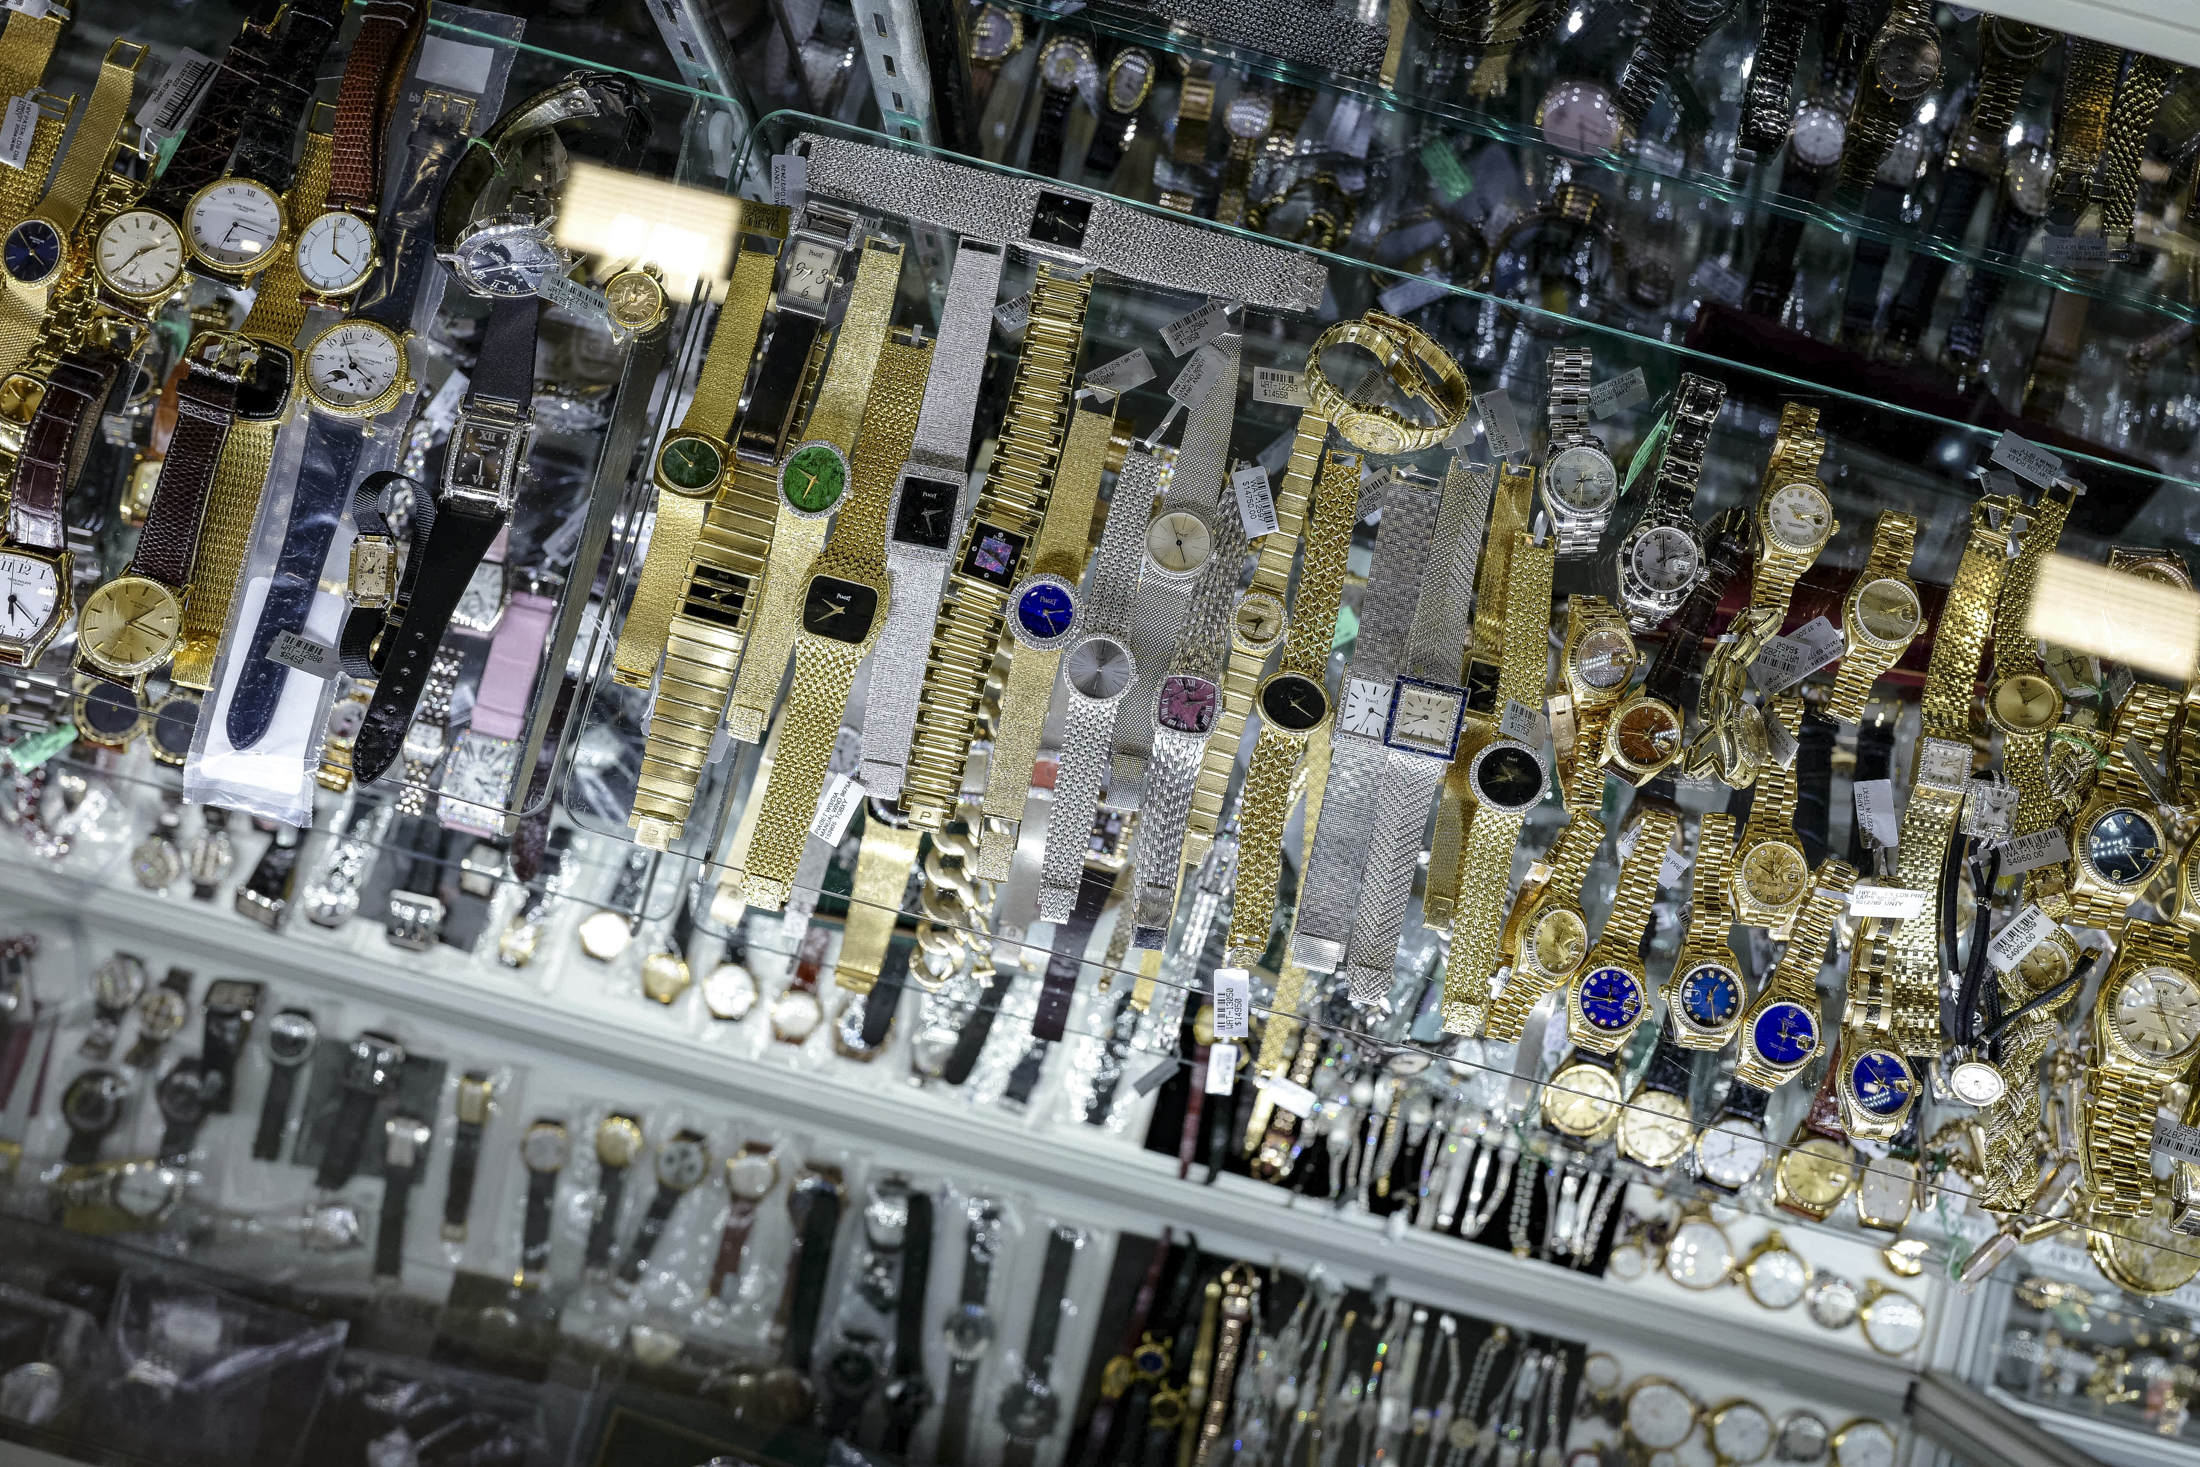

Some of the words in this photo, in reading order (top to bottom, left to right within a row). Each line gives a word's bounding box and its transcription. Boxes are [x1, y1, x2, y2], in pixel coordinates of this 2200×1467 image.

[18, 114, 28, 135] PATEK
[808, 249, 824, 258] PIAGET
[546, 283, 589, 310] WAT-12779
[1178, 331, 1200, 347] $7950
[1259, 380, 1298, 392] WAT-12253
[1263, 388, 1288, 399] $14550
[2006, 452, 2027, 466] ROLEX
[1242, 480, 1256, 520] $14750.00
[1249, 478, 1264, 522] WAT-12597
[1352, 490, 1381, 514] T-12869
[16, 562, 31, 575] 12
[836, 592, 851, 601] PIAGET
[1039, 595, 1058, 606] PIAGET
[278, 650, 304, 665] $6450
[280, 642, 323, 663] WAT-12880
[1775, 641, 1799, 655] $6450
[813, 812, 828, 834] PIAGET
[818, 811, 835, 838] MANUAL
[831, 797, 842, 813] WIND
[2006, 849, 2044, 865] $4950.00
[1999, 918, 2037, 956] WAT-11559
[2005, 931, 2036, 961] $4950.00
[1225, 987, 1233, 1029] WAT-13050
[1234, 998, 1242, 1025] $14950
